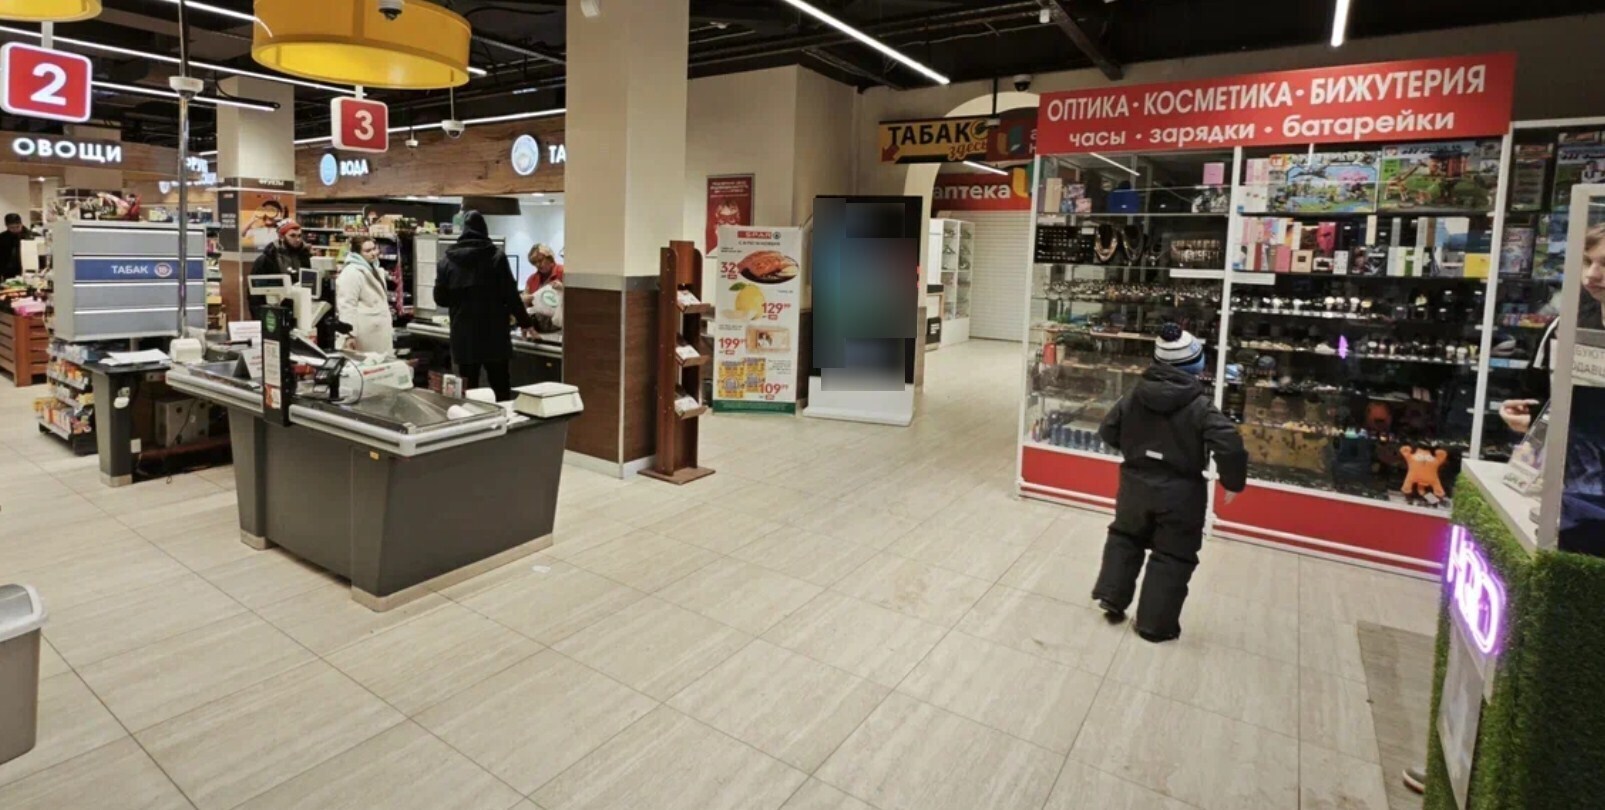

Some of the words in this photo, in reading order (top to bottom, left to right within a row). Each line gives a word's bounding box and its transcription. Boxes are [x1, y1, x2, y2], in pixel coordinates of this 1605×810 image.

[30, 62, 68, 106] 2
[1046, 93, 1130, 122] ОПТИКА
[1143, 80, 1293, 116] КОСМЕТИКА
[1309, 64, 1487, 106] БИЖУТЕРИЯ
[353, 109, 375, 141] 3
[888, 122, 971, 146] ТАБАК
[1068, 130, 1126, 147] часы
[1148, 122, 1256, 147] зарядки
[1282, 108, 1456, 140] батарейки
[12, 136, 122, 163] ОВОЩИ
[340, 159, 369, 176] ВОДА
[934, 184, 1011, 200] аптека
[110, 264, 149, 274] ТАБАК
